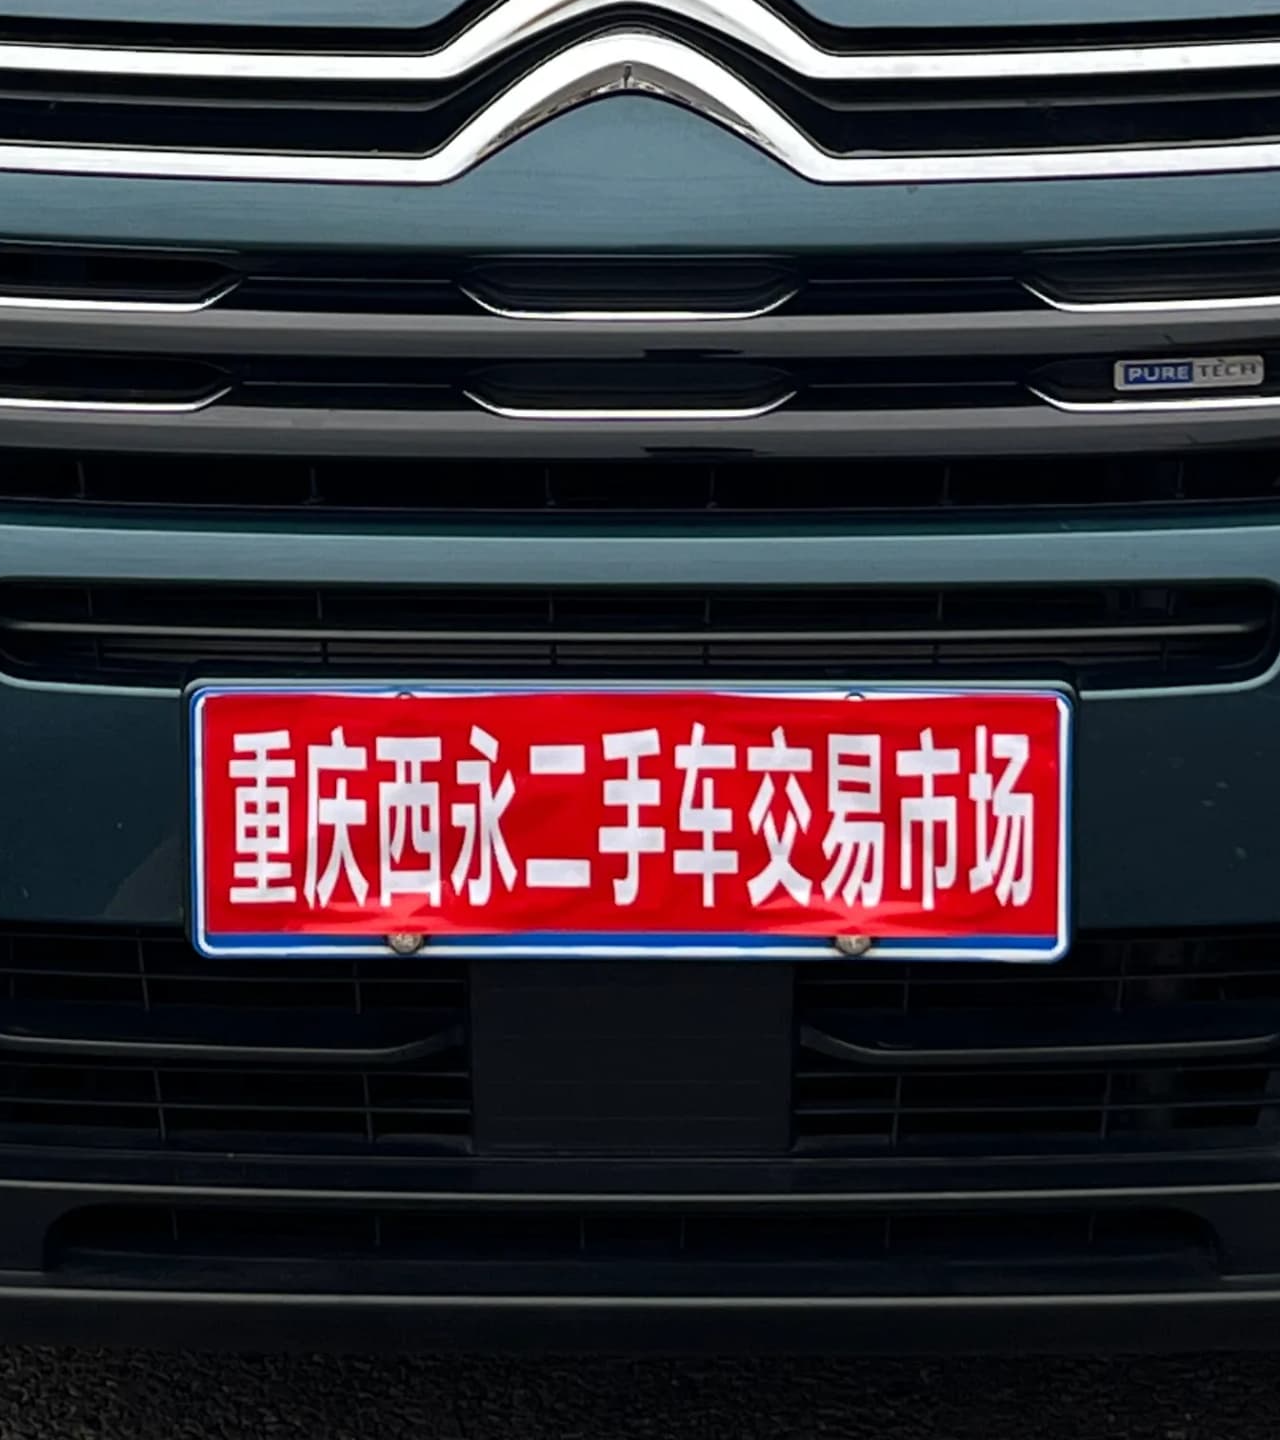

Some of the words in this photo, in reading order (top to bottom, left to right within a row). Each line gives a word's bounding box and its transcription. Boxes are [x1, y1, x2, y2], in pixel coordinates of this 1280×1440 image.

[1127, 364, 1190, 383] PURE
[1198, 359, 1258, 379] TECH
[228, 723, 1034, 910] 重庆西永二手车交易市场
